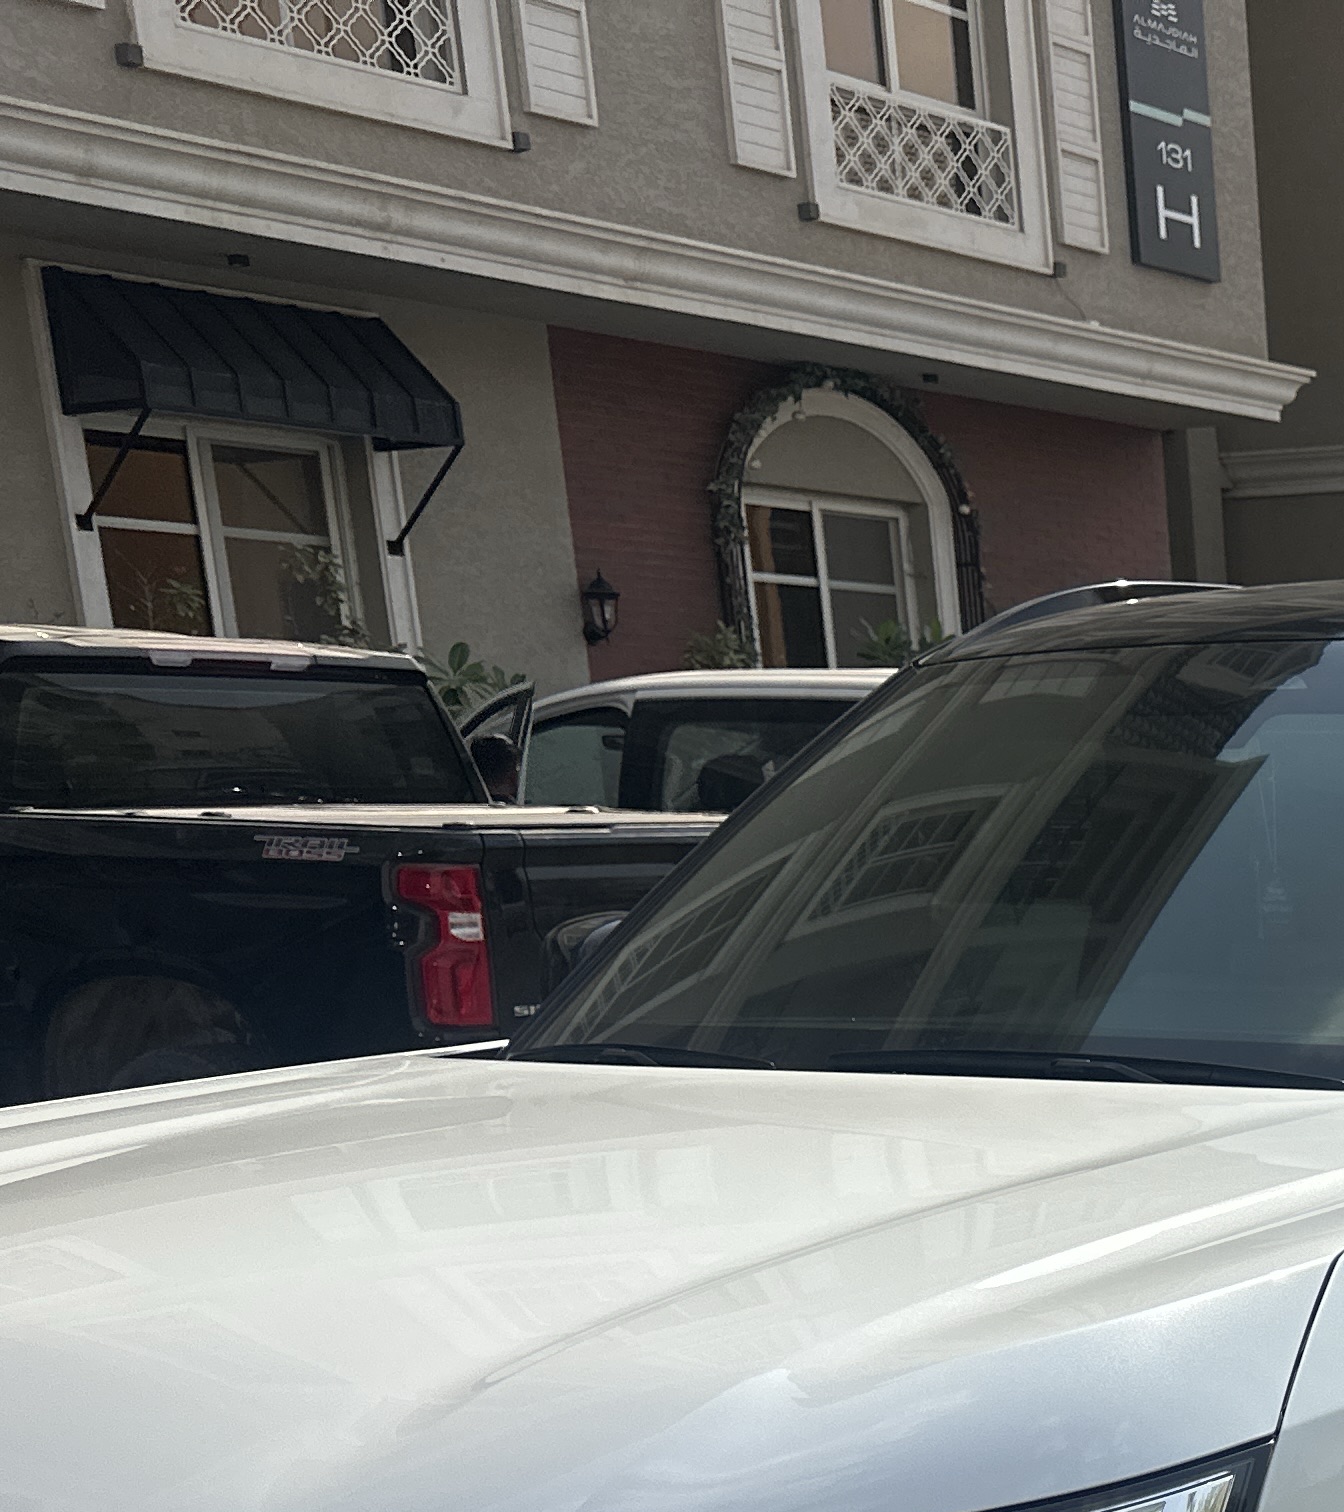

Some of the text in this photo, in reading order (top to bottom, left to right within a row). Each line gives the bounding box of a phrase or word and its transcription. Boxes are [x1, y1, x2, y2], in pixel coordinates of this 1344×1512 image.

[1133, 14, 1198, 44] ALMAJDIAH
[1133, 26, 1199, 59] الماجدية
[1156, 141, 1193, 172] 131
[1155, 184, 1201, 249] H
[254, 834, 360, 853] TRAIL
